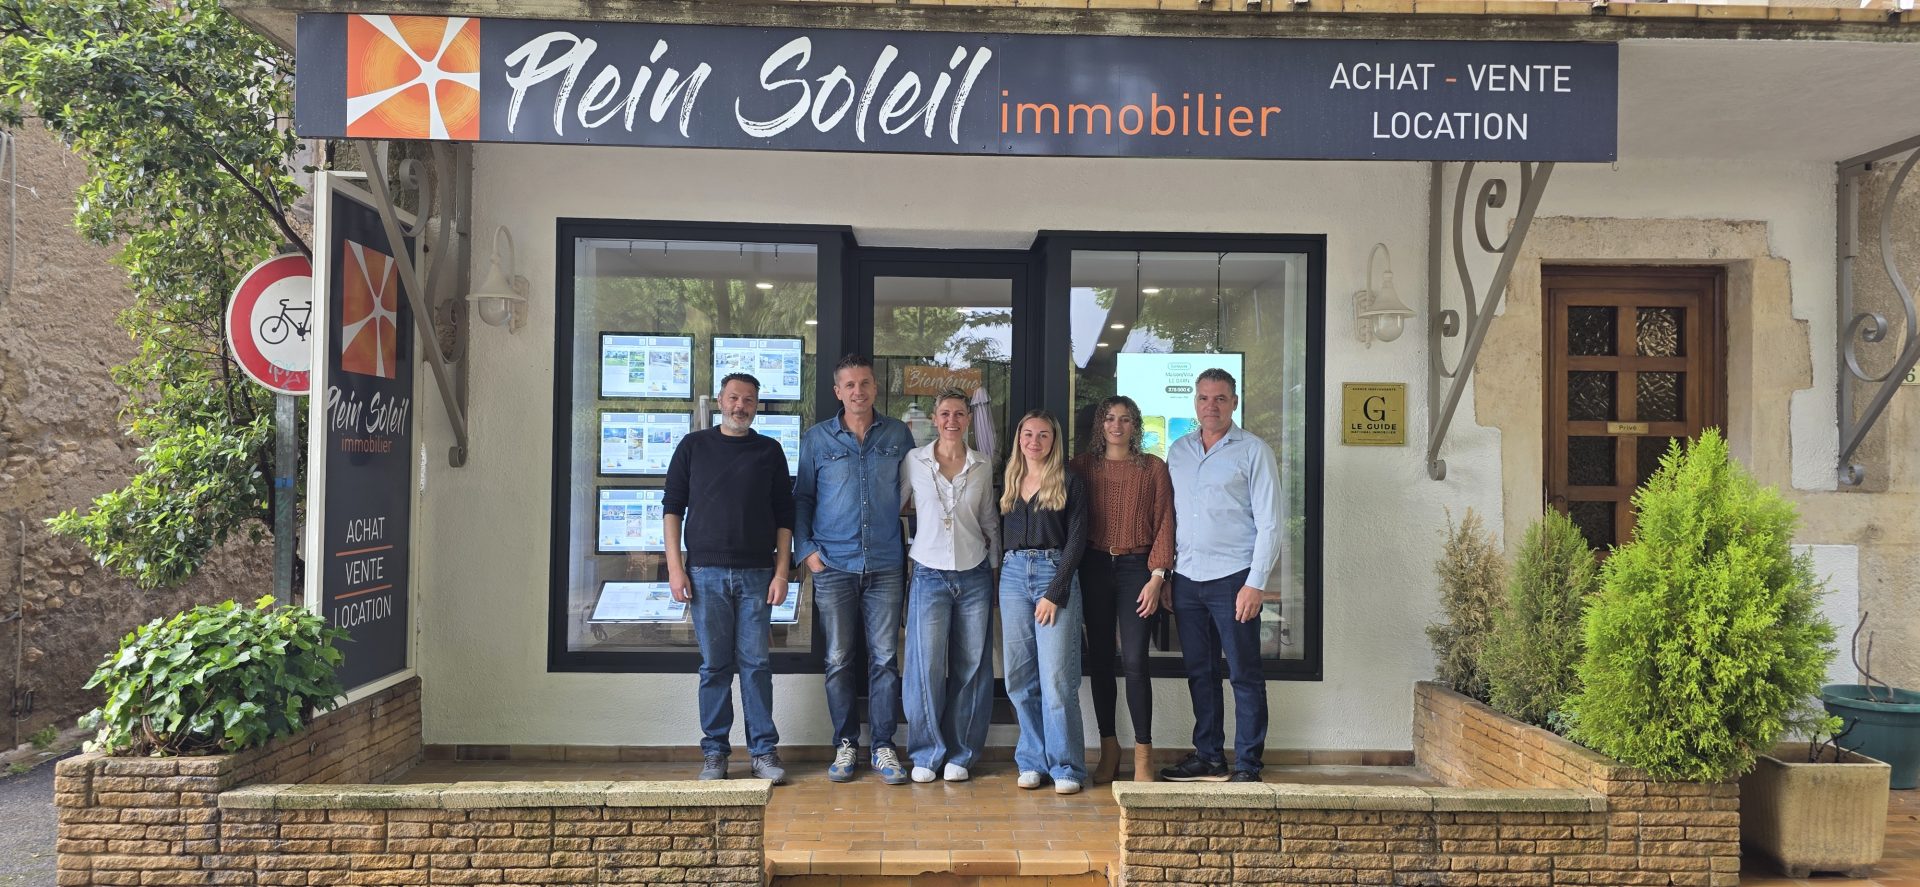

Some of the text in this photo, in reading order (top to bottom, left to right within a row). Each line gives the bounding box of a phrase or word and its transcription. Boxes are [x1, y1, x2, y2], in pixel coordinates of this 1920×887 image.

[505, 31, 992, 145] Plein Soleil
[1329, 62, 1436, 91] ACHAT
[1467, 63, 1572, 93] VENTE
[1001, 90, 1281, 137] immobilier
[1372, 111, 1528, 141] LOCATION
[906, 368, 979, 391] Bienvenue
[328, 385, 409, 436] Plein Soleil
[1363, 395, 1385, 422] G
[1366, 423, 1397, 431] GUIDE
[341, 433, 393, 454] immobilier
[346, 516, 386, 544] ACHAT
[345, 556, 385, 586] VENTE
[334, 594, 393, 629] LOCATION
